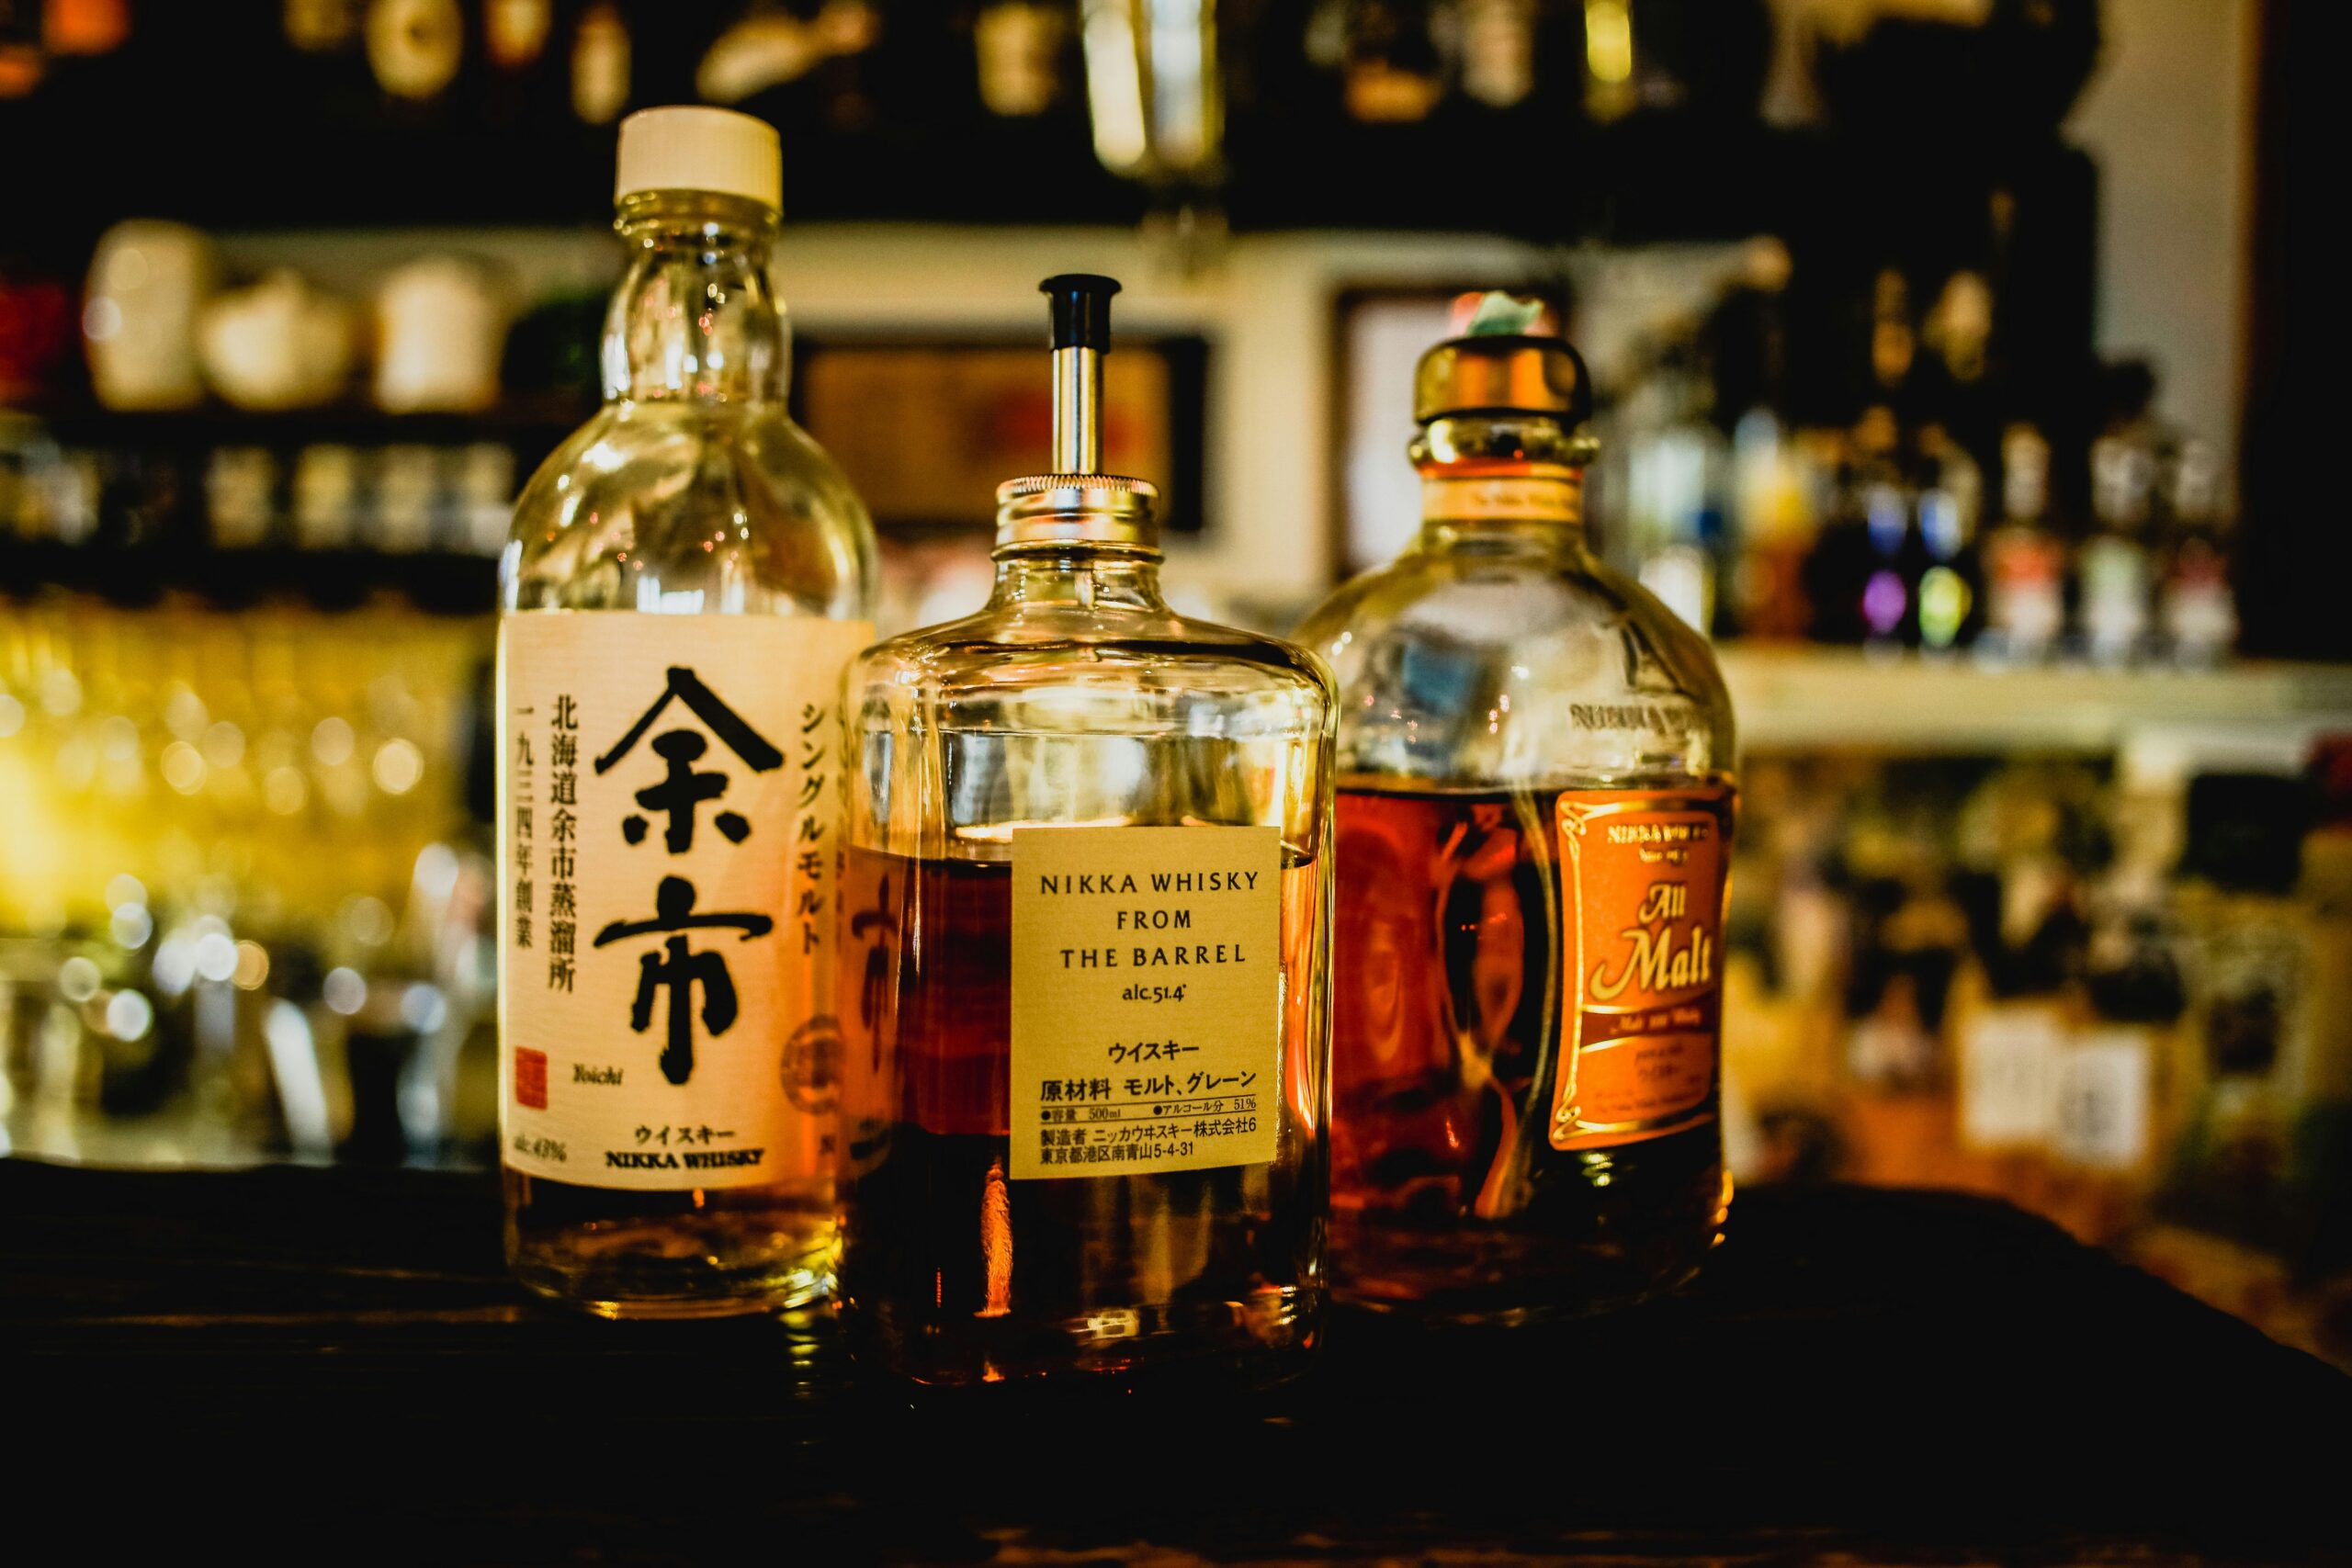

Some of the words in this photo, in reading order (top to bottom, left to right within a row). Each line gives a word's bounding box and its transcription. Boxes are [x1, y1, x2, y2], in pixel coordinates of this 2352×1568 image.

[796, 701, 827, 956] シングルモルト
[547, 694, 580, 995] 北海道余市蒸溜所
[594, 666, 785, 1086] 余市
[1040, 874, 1138, 895] NIKKA
[1151, 871, 1259, 892] WHISKY
[1638, 882, 1687, 925] All
[1116, 909, 1193, 931] FROM
[1060, 948, 1118, 969] THE
[1133, 944, 1246, 967] BARREL
[1590, 925, 1712, 1001] Malt
[1108, 1040, 1200, 1065] ウイスキー
[572, 1064, 624, 1086] Yoichi
[1040, 1077, 1113, 1102] 原材料
[1052, 1108, 1077, 1122] 容量
[1089, 1108, 1121, 1120] 500ml
[1234, 1098, 1257, 1111] 51%
[635, 1125, 736, 1146] ウイスキー
[605, 1150, 680, 1169] NIKKA
[682, 1148, 765, 1168] WHISKY
